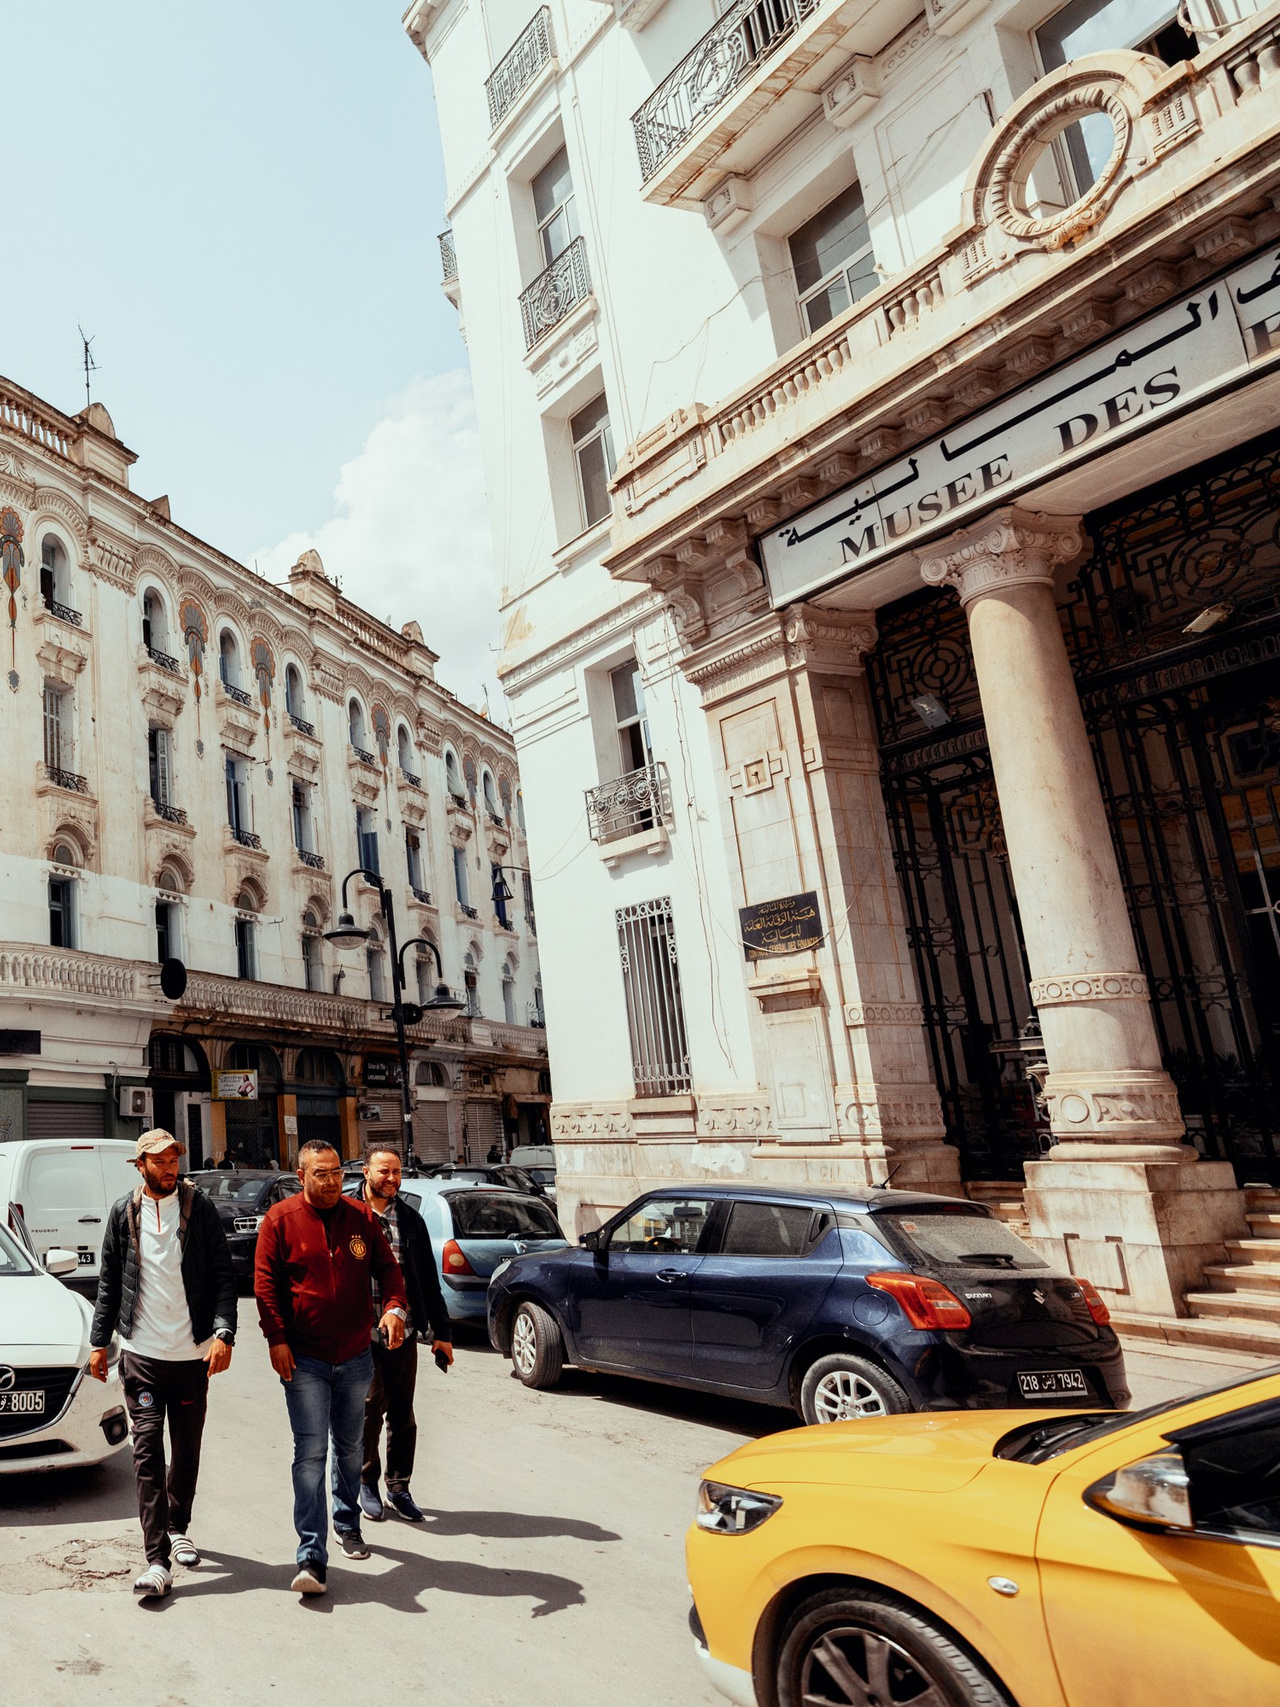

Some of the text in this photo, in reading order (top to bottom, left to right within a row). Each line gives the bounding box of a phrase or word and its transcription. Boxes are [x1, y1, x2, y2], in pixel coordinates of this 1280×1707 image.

[837, 365, 1182, 566] MUSEE DES
[78, 1254, 91, 1263] 43
[1020, 1375, 1039, 1391] 218
[1057, 1373, 1084, 1388] 7942
[10, 1392, 43, 1411] 8005
